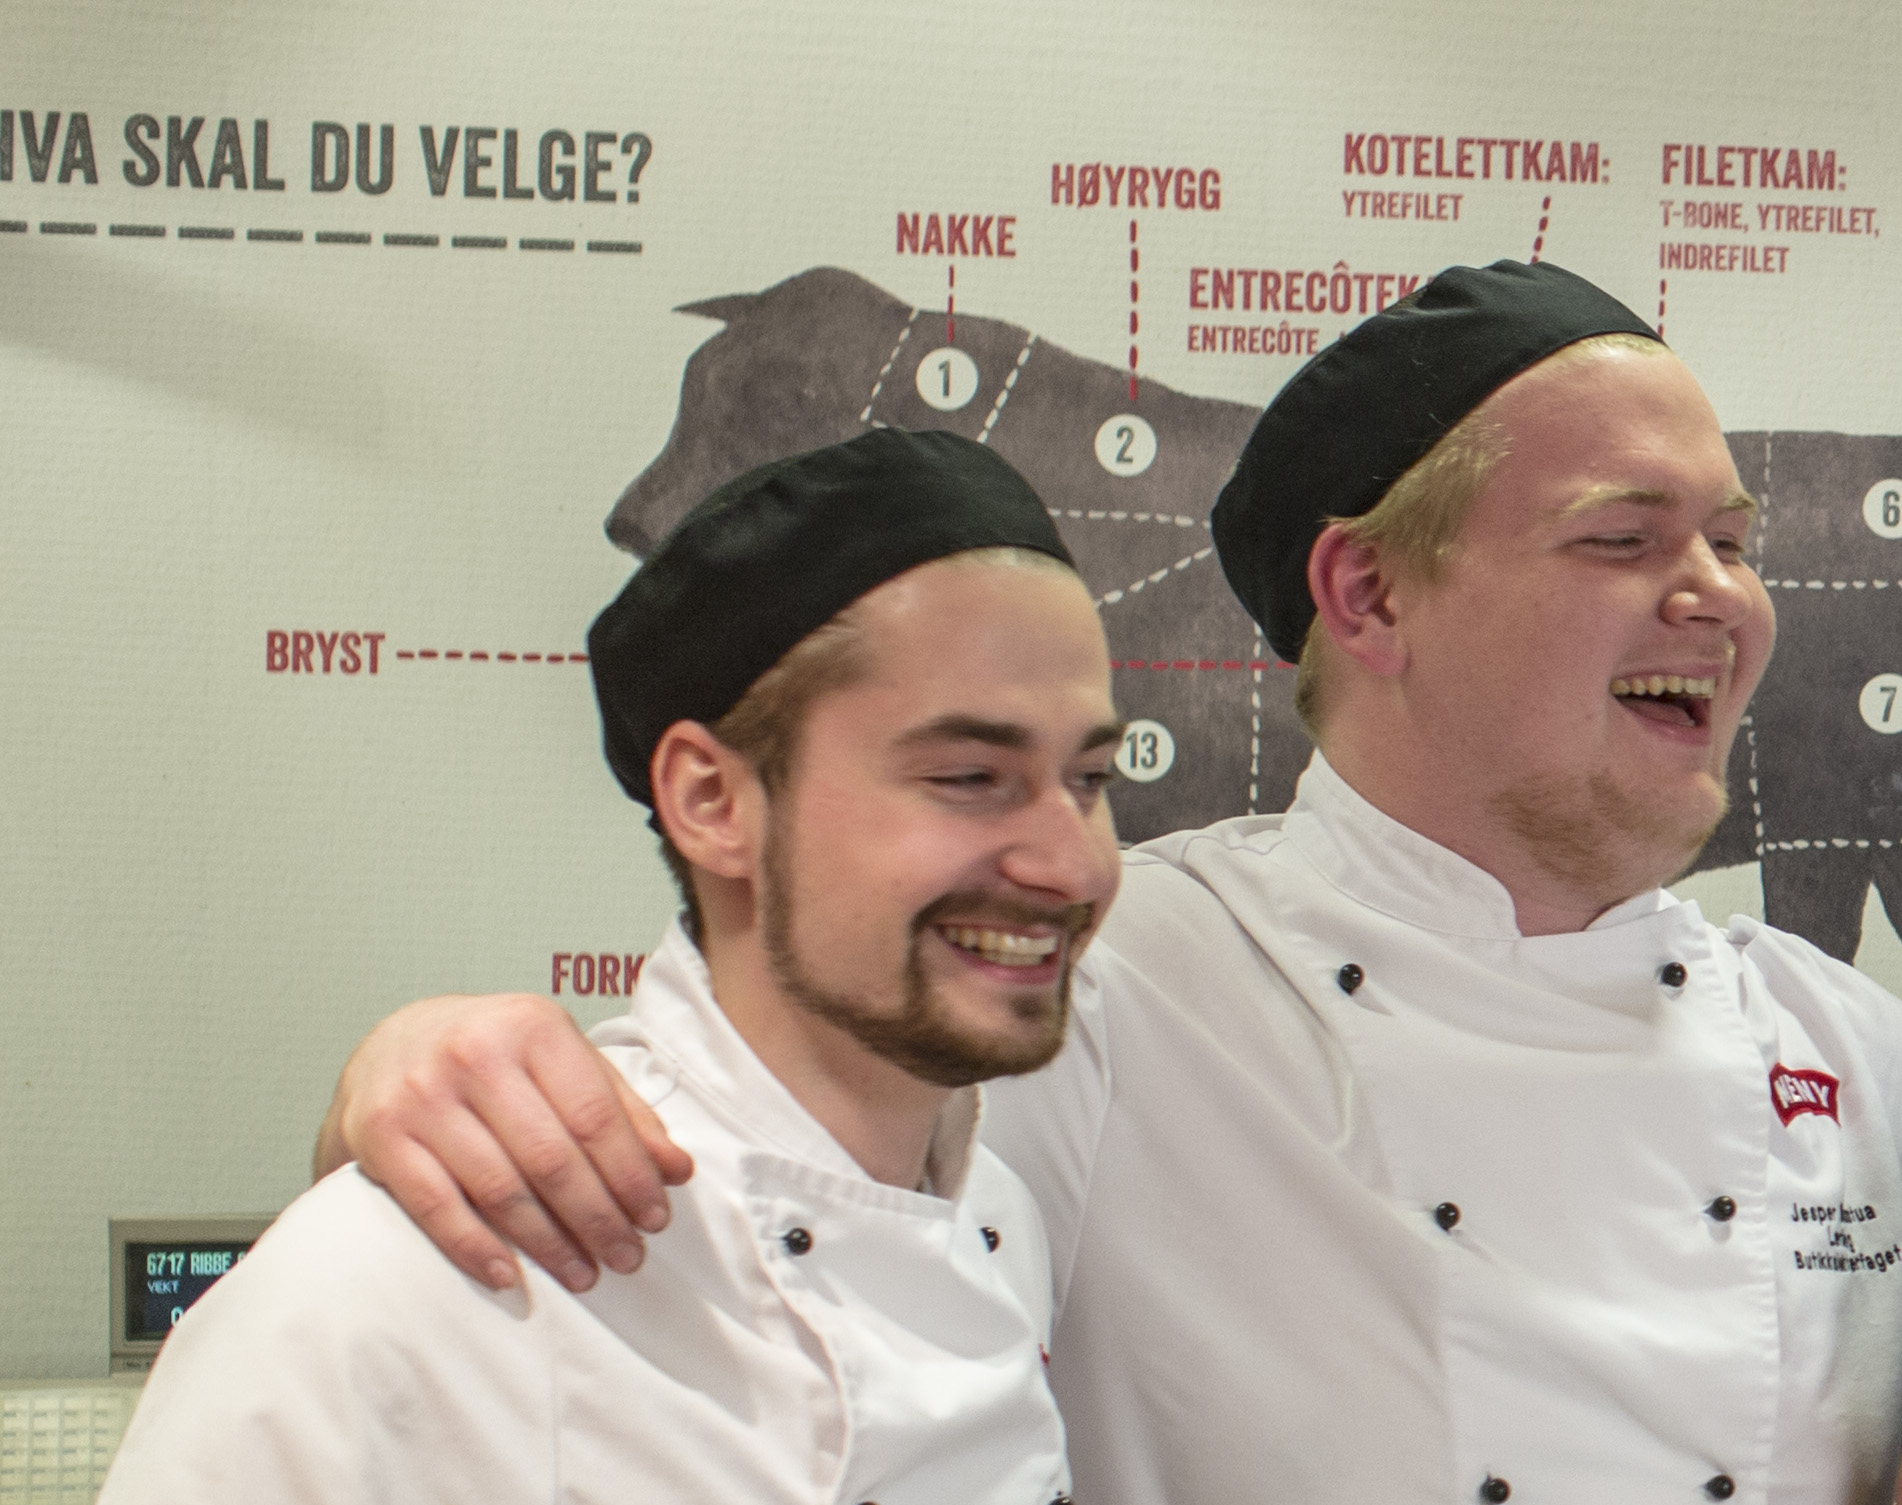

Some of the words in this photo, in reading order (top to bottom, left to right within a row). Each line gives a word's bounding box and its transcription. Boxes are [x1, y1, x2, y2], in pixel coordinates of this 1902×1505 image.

[123, 112, 285, 192] SKAL
[311, 120, 394, 195] DU
[420, 125, 654, 204] VELGE?
[1343, 133, 1610, 186] KOTELETTKAM:
[1662, 144, 1848, 191] FILETKAM:
[1051, 163, 1221, 212] HØYRYGG
[1342, 191, 1463, 222] YTREFILET
[896, 211, 1017, 259] NAKKE
[1660, 202, 1750, 235] T-BONE,
[1757, 204, 1881, 239] YTREFILET,
[1659, 242, 1790, 274] INDREFILET
[1189, 260, 1434, 315] ENTRECÔTEK
[1187, 320, 1320, 356] ENTRECÔTE
[940, 359, 952, 398] 1
[1115, 426, 1135, 464] 2
[1882, 491, 1901, 527] 6
[266, 630, 386, 675] BRYST
[1880, 686, 1898, 722] 7
[1126, 731, 1159, 770] 13
[1773, 1074, 1830, 1109] MENY
[147, 1252, 185, 1276] 6717
[147, 1280, 180, 1294] VEKT
